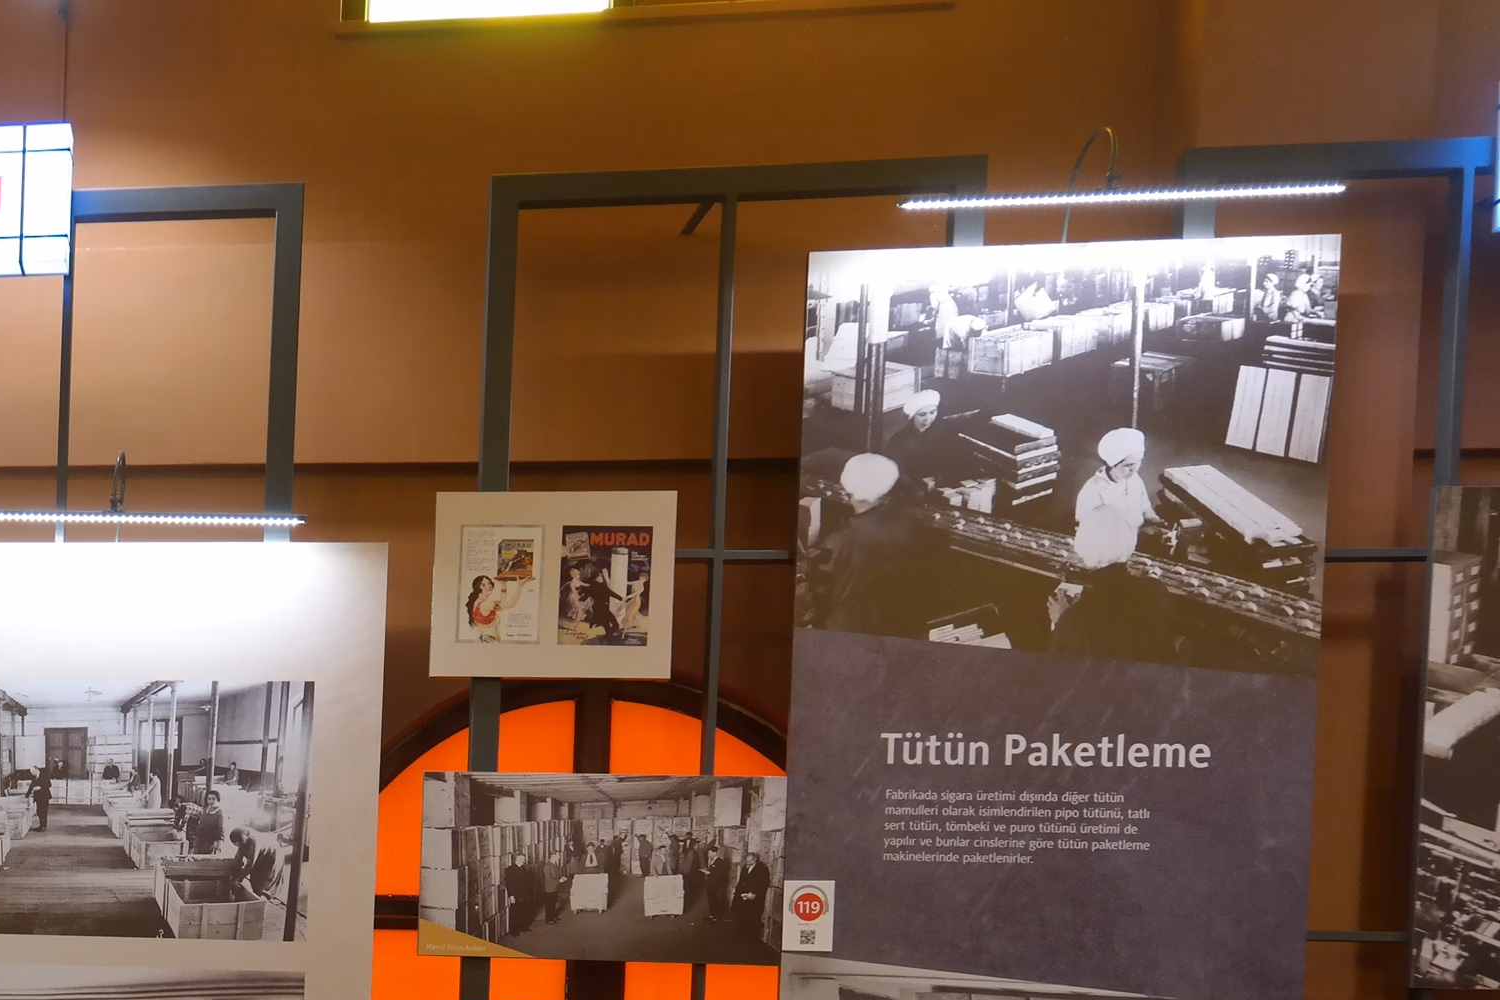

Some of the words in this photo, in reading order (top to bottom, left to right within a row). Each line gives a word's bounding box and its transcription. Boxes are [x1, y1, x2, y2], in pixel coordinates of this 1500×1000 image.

[590, 532, 650, 546] MURAD
[880, 732, 990, 766] Tütün
[1004, 733, 1212, 768] Paketleme
[886, 788, 938, 800] Fabrikada
[940, 789, 973, 804] sigara
[976, 790, 1016, 801] üretimi
[1019, 790, 1058, 804] dışında
[1061, 791, 1091, 805] diğer
[1093, 791, 1124, 803] tütün
[885, 804, 939, 816] mamulleri
[942, 804, 976, 816] olarak
[978, 805, 1052, 817] isimlendirilen
[1054, 806, 1080, 821] pipo
[1082, 807, 1124, 821] tütünü,
[1127, 808, 1150, 819] tatlı
[884, 820, 906, 831] sert
[909, 820, 942, 833] tütün,
[945, 820, 990, 832] tömbeki
[993, 824, 1007, 832] ve
[1010, 824, 1036, 836] puro
[1038, 822, 1077, 833] tütünü
[1080, 822, 1120, 834] üretimi
[1123, 823, 1138, 834] de
[884, 835, 917, 849] yapılır
[919, 838, 933, 847] ve
[936, 836, 971, 848] bunlar
[973, 836, 1026, 848] cinslerine
[1028, 837, 1055, 852] göre
[1057, 838, 1088, 849] tütün
[1091, 838, 1151, 853] paketleme
[883, 850, 960, 863] makinelerinde
[962, 851, 1034, 865] paketlenirler.
[797, 901, 820, 914] 119
